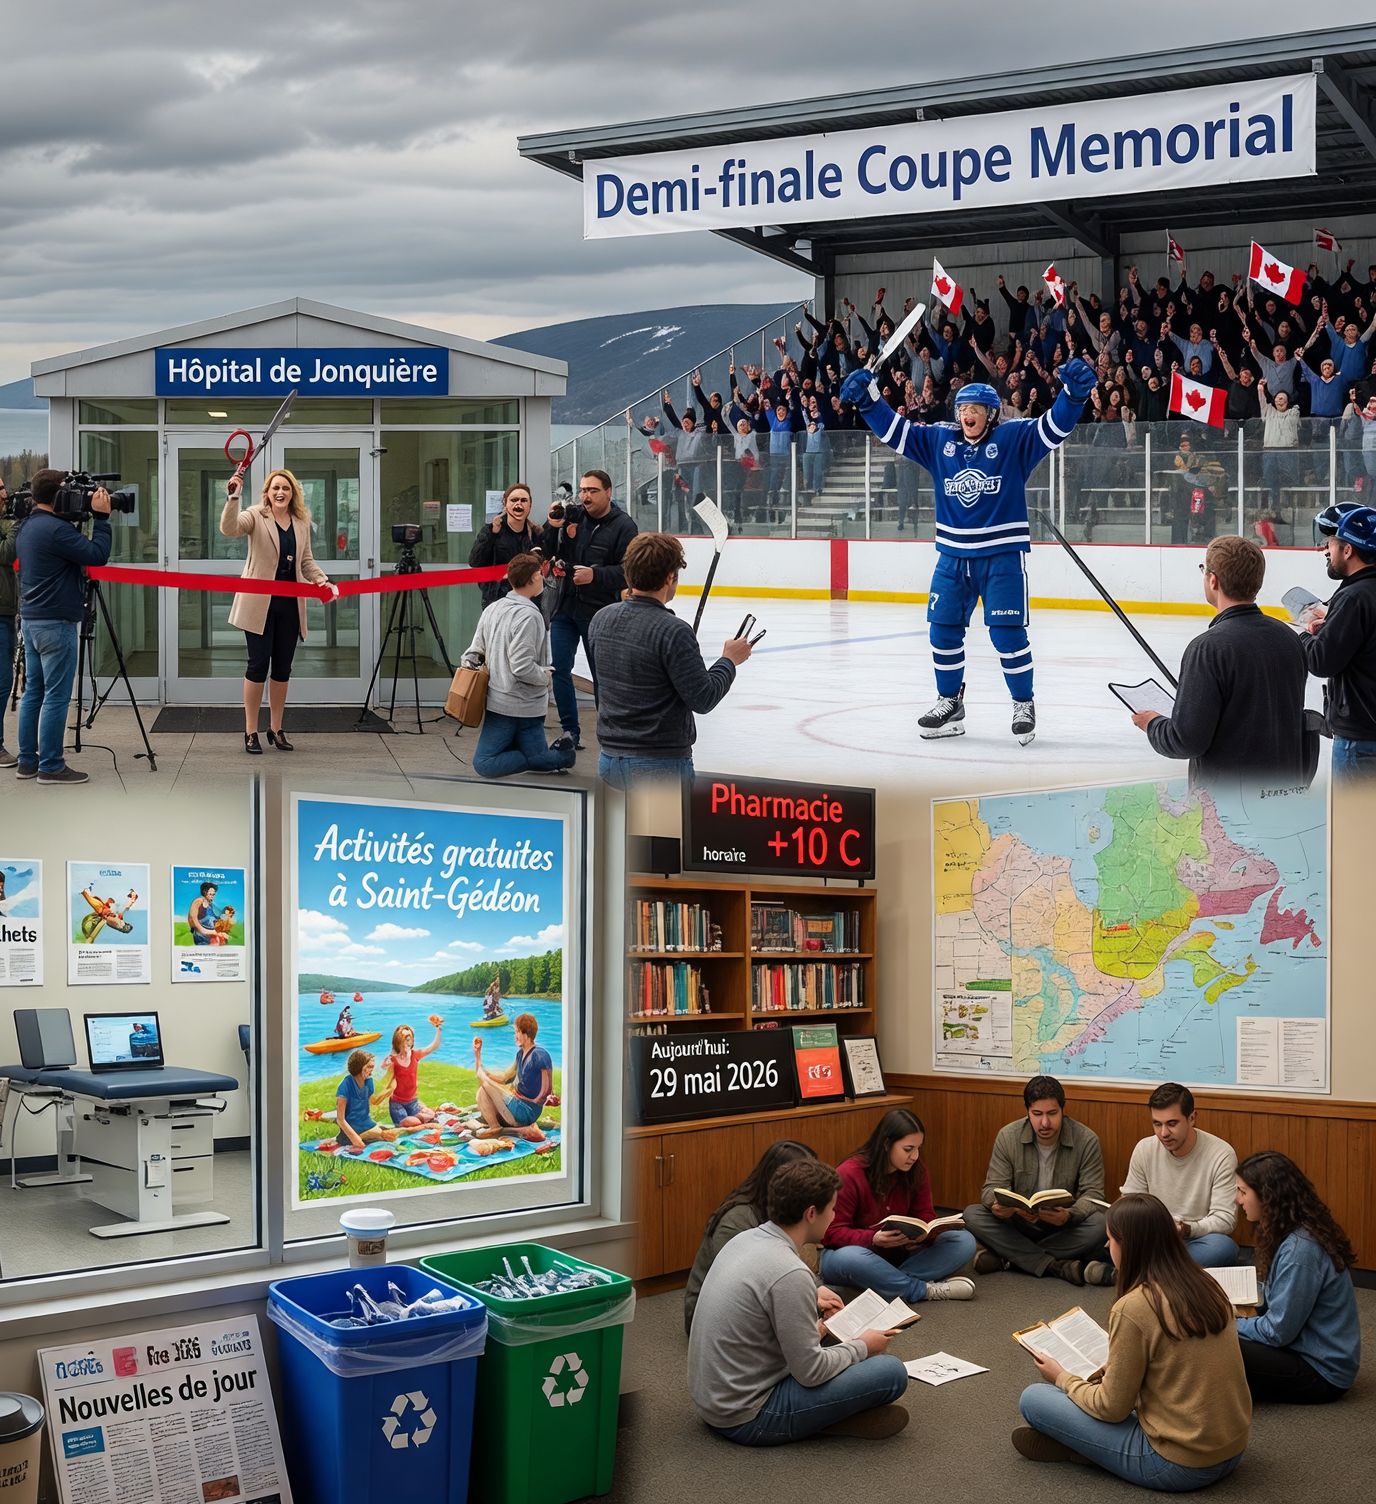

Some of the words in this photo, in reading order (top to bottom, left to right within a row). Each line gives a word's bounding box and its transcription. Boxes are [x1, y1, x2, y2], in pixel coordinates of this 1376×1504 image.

[596, 149, 843, 219] Demi-finale
[857, 144, 1012, 201] Coupe
[1030, 94, 1294, 179] Memorial
[168, 357, 261, 389] Hôpital
[269, 357, 302, 383] de
[309, 358, 438, 389] Jonquière
[711, 783, 844, 823] Pharmacie
[313, 823, 435, 865] Activités
[439, 838, 554, 879] gratuites
[767, 826, 828, 866] +10
[839, 828, 861, 867] C
[328, 872, 348, 907] à
[356, 871, 541, 919] Saint-Gédéon
[649, 1067, 678, 1099] 29
[684, 1064, 721, 1095] mai
[727, 1059, 779, 1092] 2026
[58, 1383, 174, 1424] Nouvelles
[178, 1374, 207, 1400] de
[213, 1370, 257, 1402] jour
